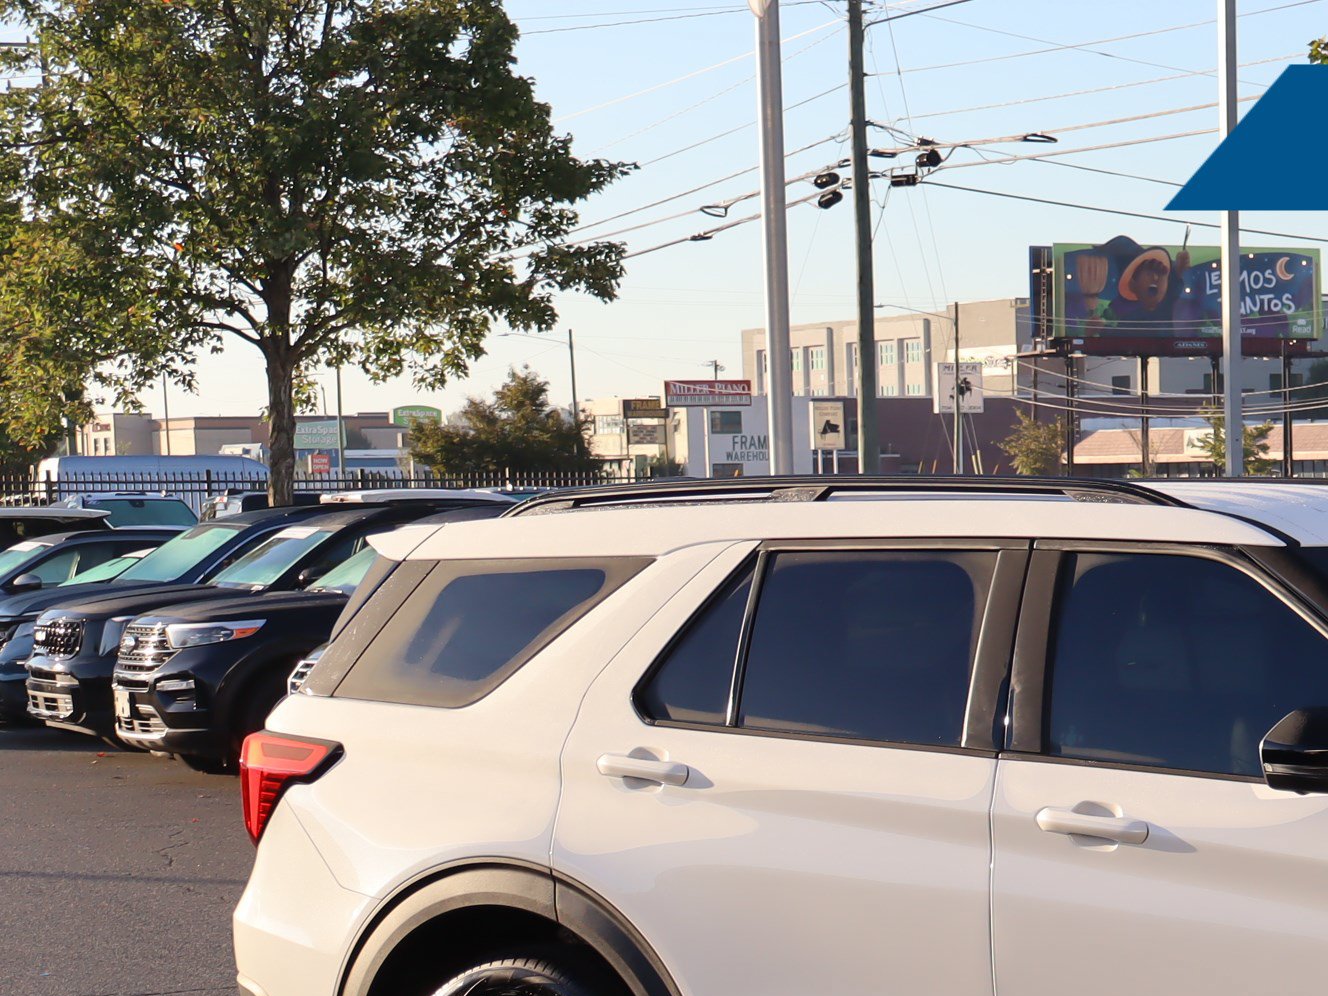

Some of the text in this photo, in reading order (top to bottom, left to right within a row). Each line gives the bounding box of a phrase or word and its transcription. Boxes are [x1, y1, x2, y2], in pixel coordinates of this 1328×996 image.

[669, 383, 749, 394] MILLER PIANO
[631, 401, 661, 410] FRAME
[296, 425, 338, 436] ExtraSpac
[303, 435, 337, 444] Storage
[732, 435, 768, 451] FRAM
[726, 451, 769, 462] WAREHOU
